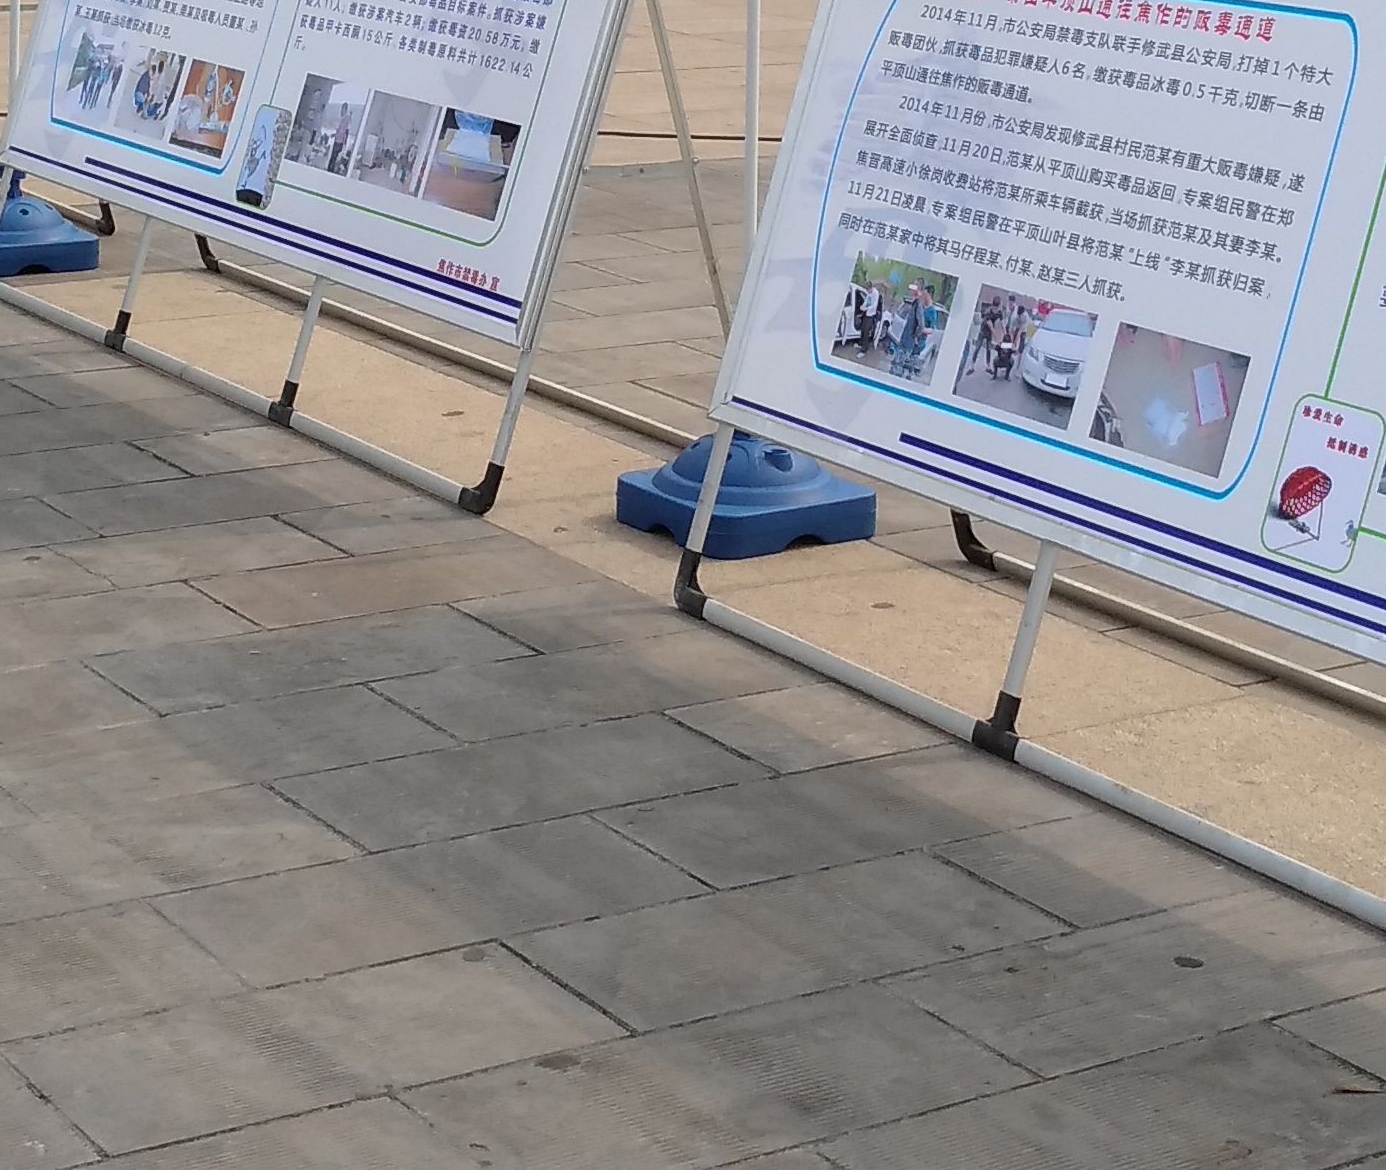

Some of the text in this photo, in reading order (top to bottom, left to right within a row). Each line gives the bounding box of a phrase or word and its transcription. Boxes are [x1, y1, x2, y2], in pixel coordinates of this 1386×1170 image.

[881, 59, 1033, 105] 平顶山通往焦作的贩毒通道。
[1302, 405, 1345, 427] 珍爱生命
